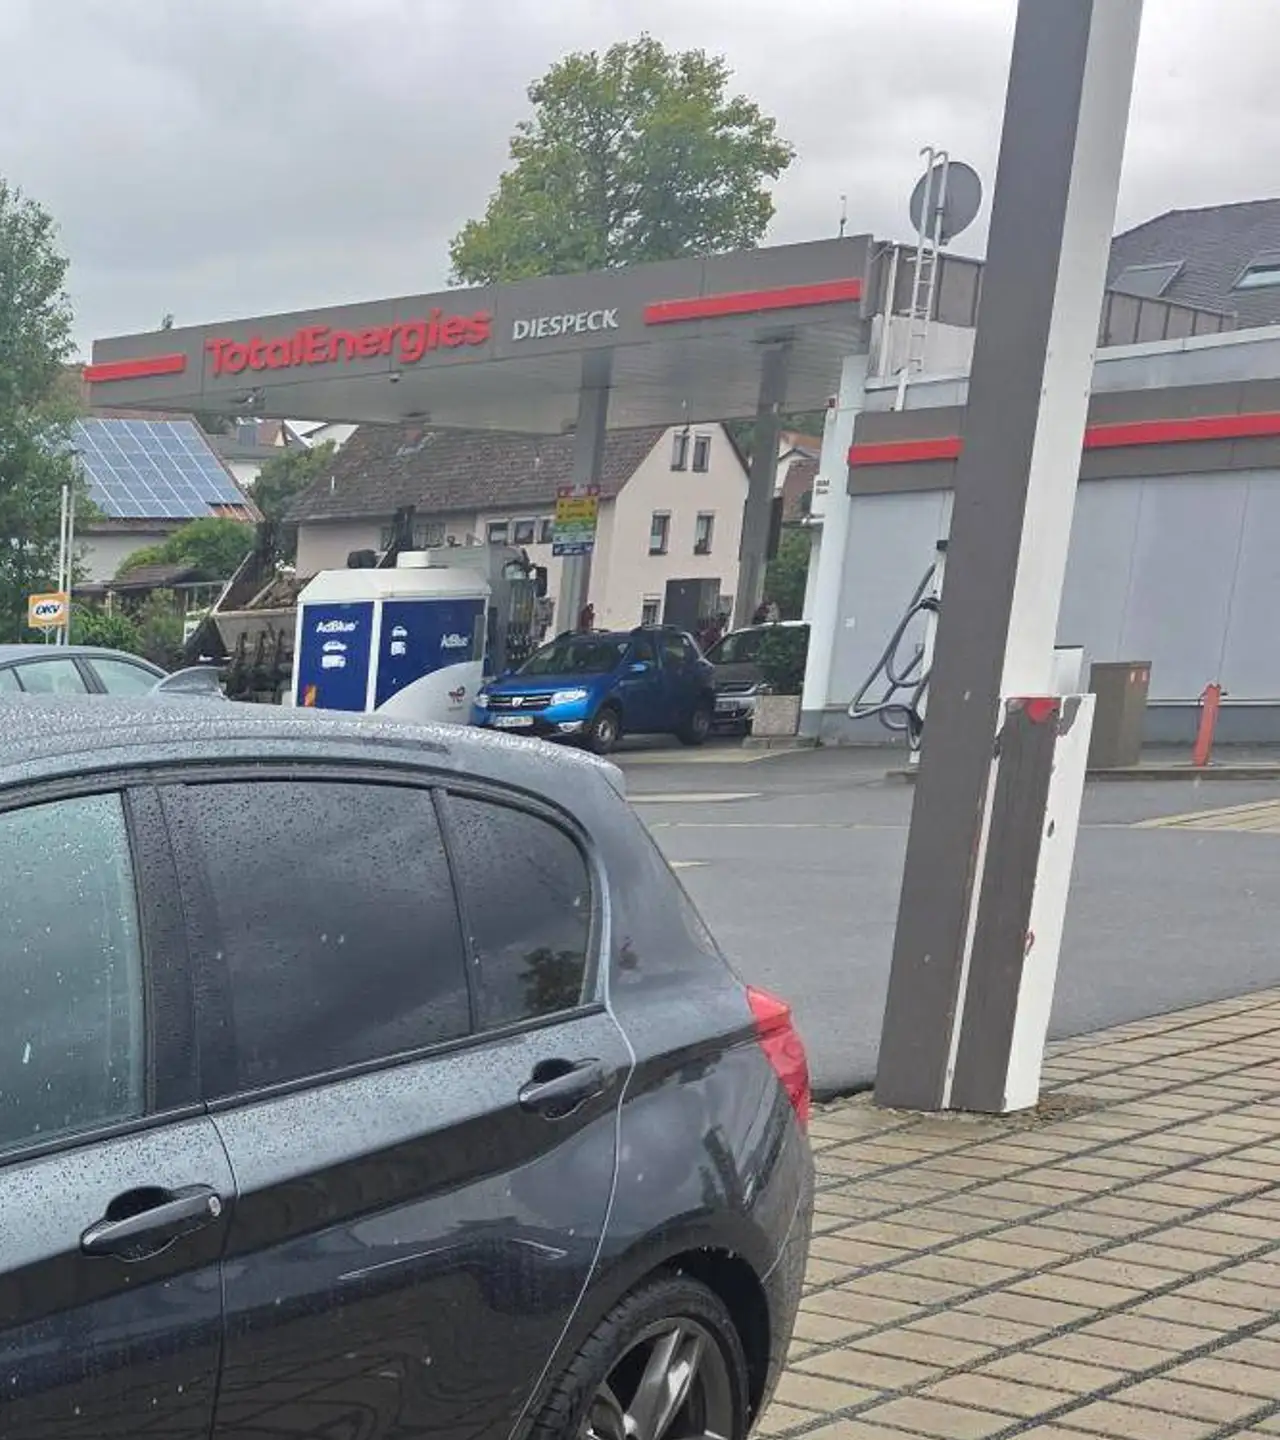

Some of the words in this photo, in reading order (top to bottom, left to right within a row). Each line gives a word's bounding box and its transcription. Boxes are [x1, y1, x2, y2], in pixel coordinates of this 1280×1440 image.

[205, 308, 493, 378] TotalEnergies
[512, 308, 619, 341] DIESPECK
[315, 619, 358, 633] AdBlue
[440, 634, 470, 648] AdBlue
